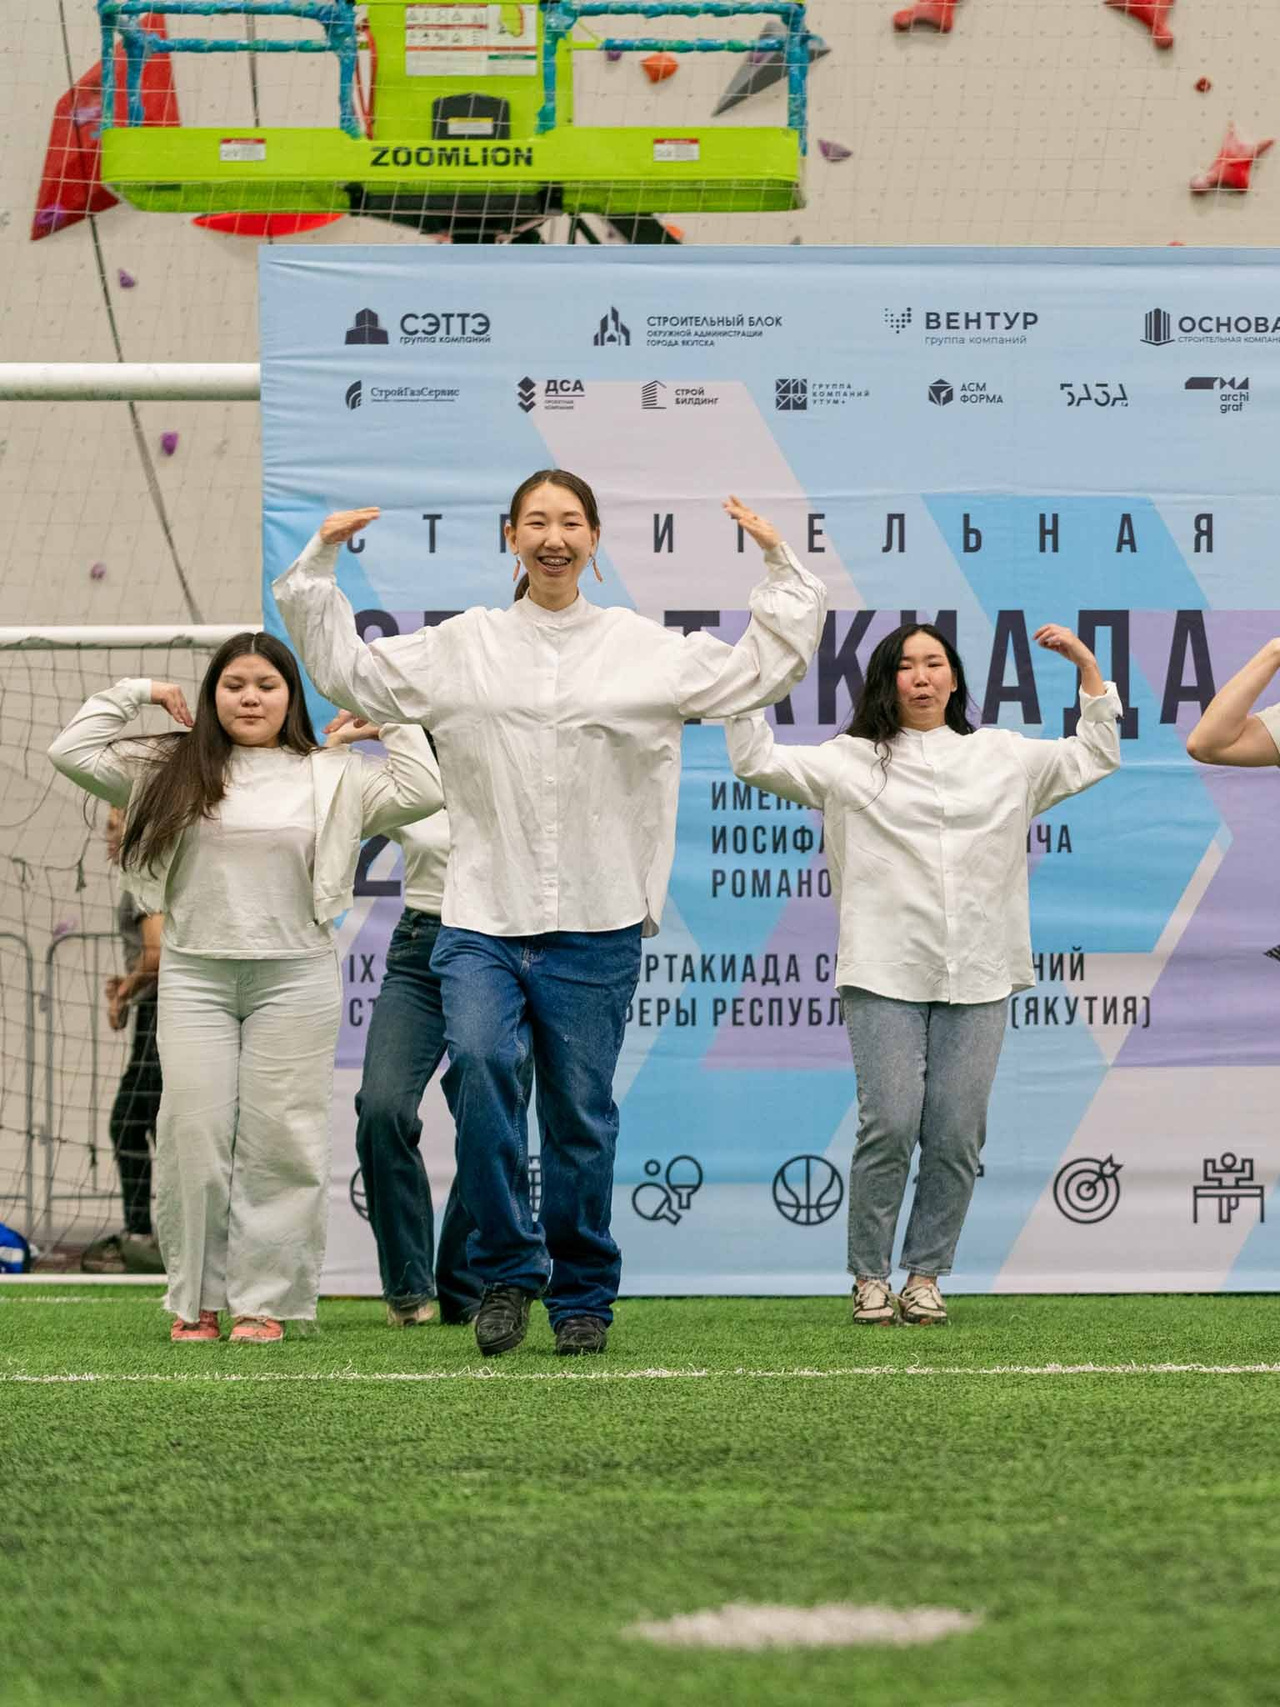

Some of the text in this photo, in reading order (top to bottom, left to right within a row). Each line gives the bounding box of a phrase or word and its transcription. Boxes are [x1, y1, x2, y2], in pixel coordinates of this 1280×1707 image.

[370, 146, 533, 167] ZOOMLION
[400, 313, 490, 336] СЭТТЭ
[646, 314, 783, 327] СТРОИТЕЛЬНЫЙ БЛОК
[925, 311, 1039, 330] ВЕНТУР
[646, 329, 692, 337] ОКРУЖНОЙ
[400, 334, 491, 345] группа компаний
[646, 339, 715, 347] ГОРОДА ЯКУТСКА
[925, 335, 1027, 346] группа компаний
[1178, 336, 1242, 344] СТРОИТЕЛЬНАЯ
[370, 386, 460, 399] СтройГазСервис
[545, 379, 585, 394] ДСА
[675, 387, 705, 396] СТРОЙ
[960, 382, 987, 392] АСМ
[674, 397, 719, 405] БИЛДИНГ
[960, 394, 1004, 404] ФОРМА
[1220, 392, 1249, 402] archi
[1220, 402, 1243, 414] graf
[711, 781, 813, 811] ИМЕ
[711, 868, 832, 898] РОМАНО
[645, 953, 801, 986] РТАКИАДА
[712, 998, 844, 1027] РЕСПУБЛ
[1011, 996, 1151, 1029] (ЯКУТИЯ)
